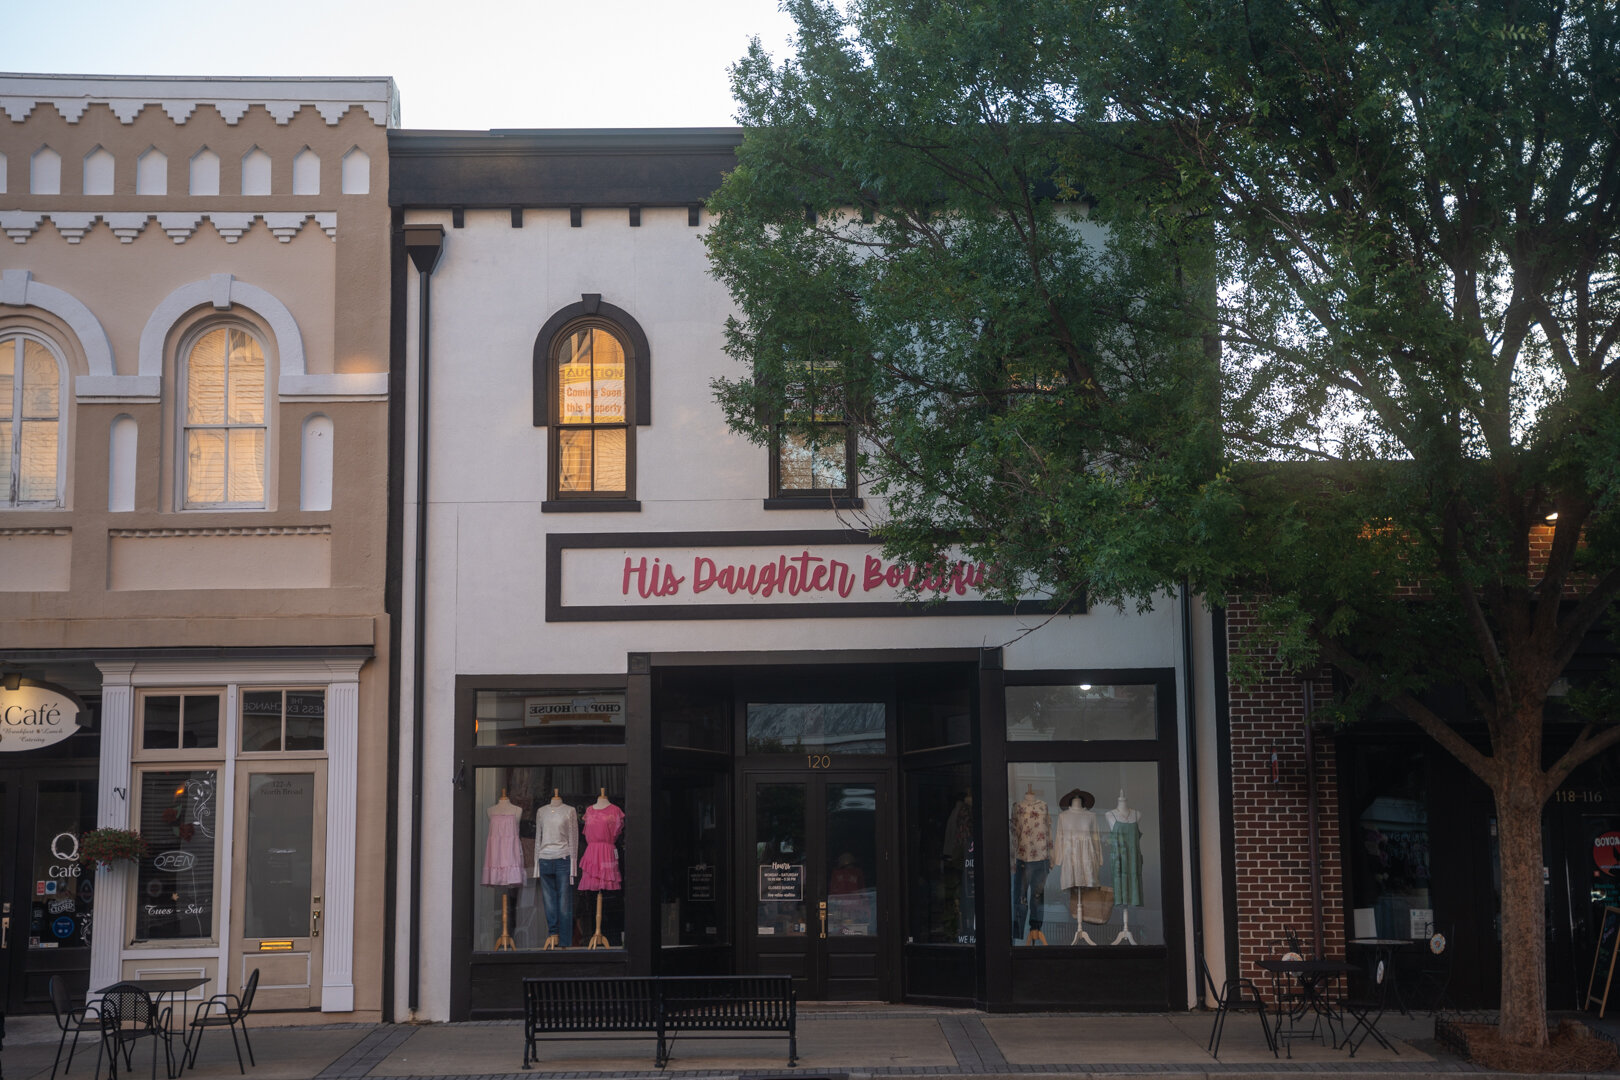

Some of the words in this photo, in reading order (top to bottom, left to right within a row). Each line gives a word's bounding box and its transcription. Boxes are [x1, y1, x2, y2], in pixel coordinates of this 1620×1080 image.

[567, 367, 624, 378] AUCTION
[601, 387, 622, 397] Soon
[566, 403, 583, 412] this
[585, 402, 622, 414] Poperty
[622, 556, 685, 598] His
[693, 550, 856, 598] Daughter
[4, 702, 61, 726] Café
[807, 754, 831, 768] 120
[51, 832, 80, 861] Q
[153, 855, 195, 867] OPEN
[48, 863, 82, 878] Café
[144, 904, 173, 915] Tues
[184, 903, 204, 915] Sat
